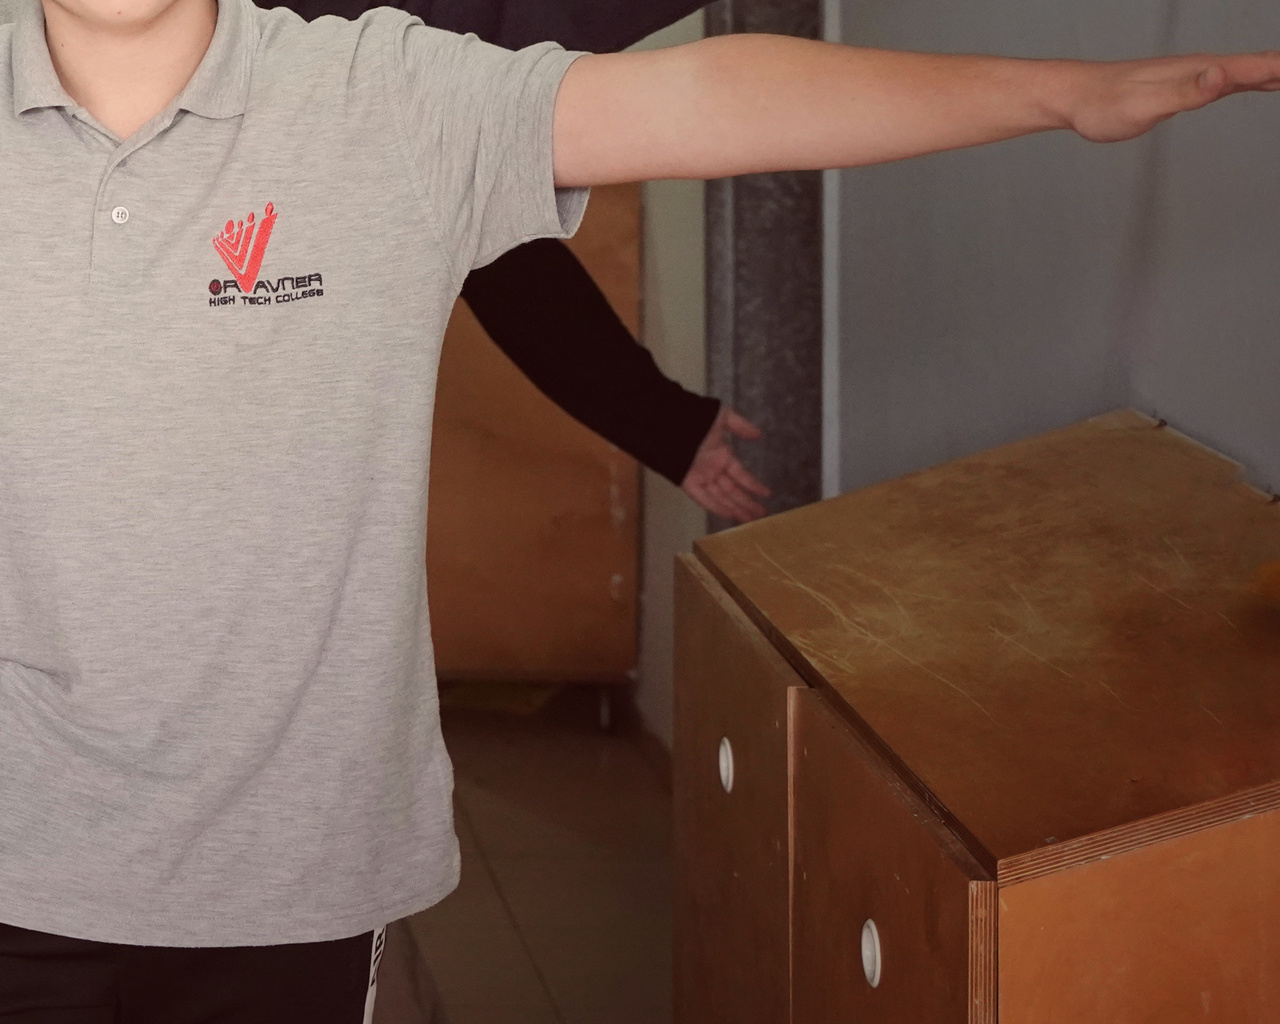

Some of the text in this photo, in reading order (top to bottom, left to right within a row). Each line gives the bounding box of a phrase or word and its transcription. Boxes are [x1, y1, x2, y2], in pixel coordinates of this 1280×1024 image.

[253, 273, 323, 295] AVNER
[208, 288, 324, 307] HIGH TECH COLLEGE
